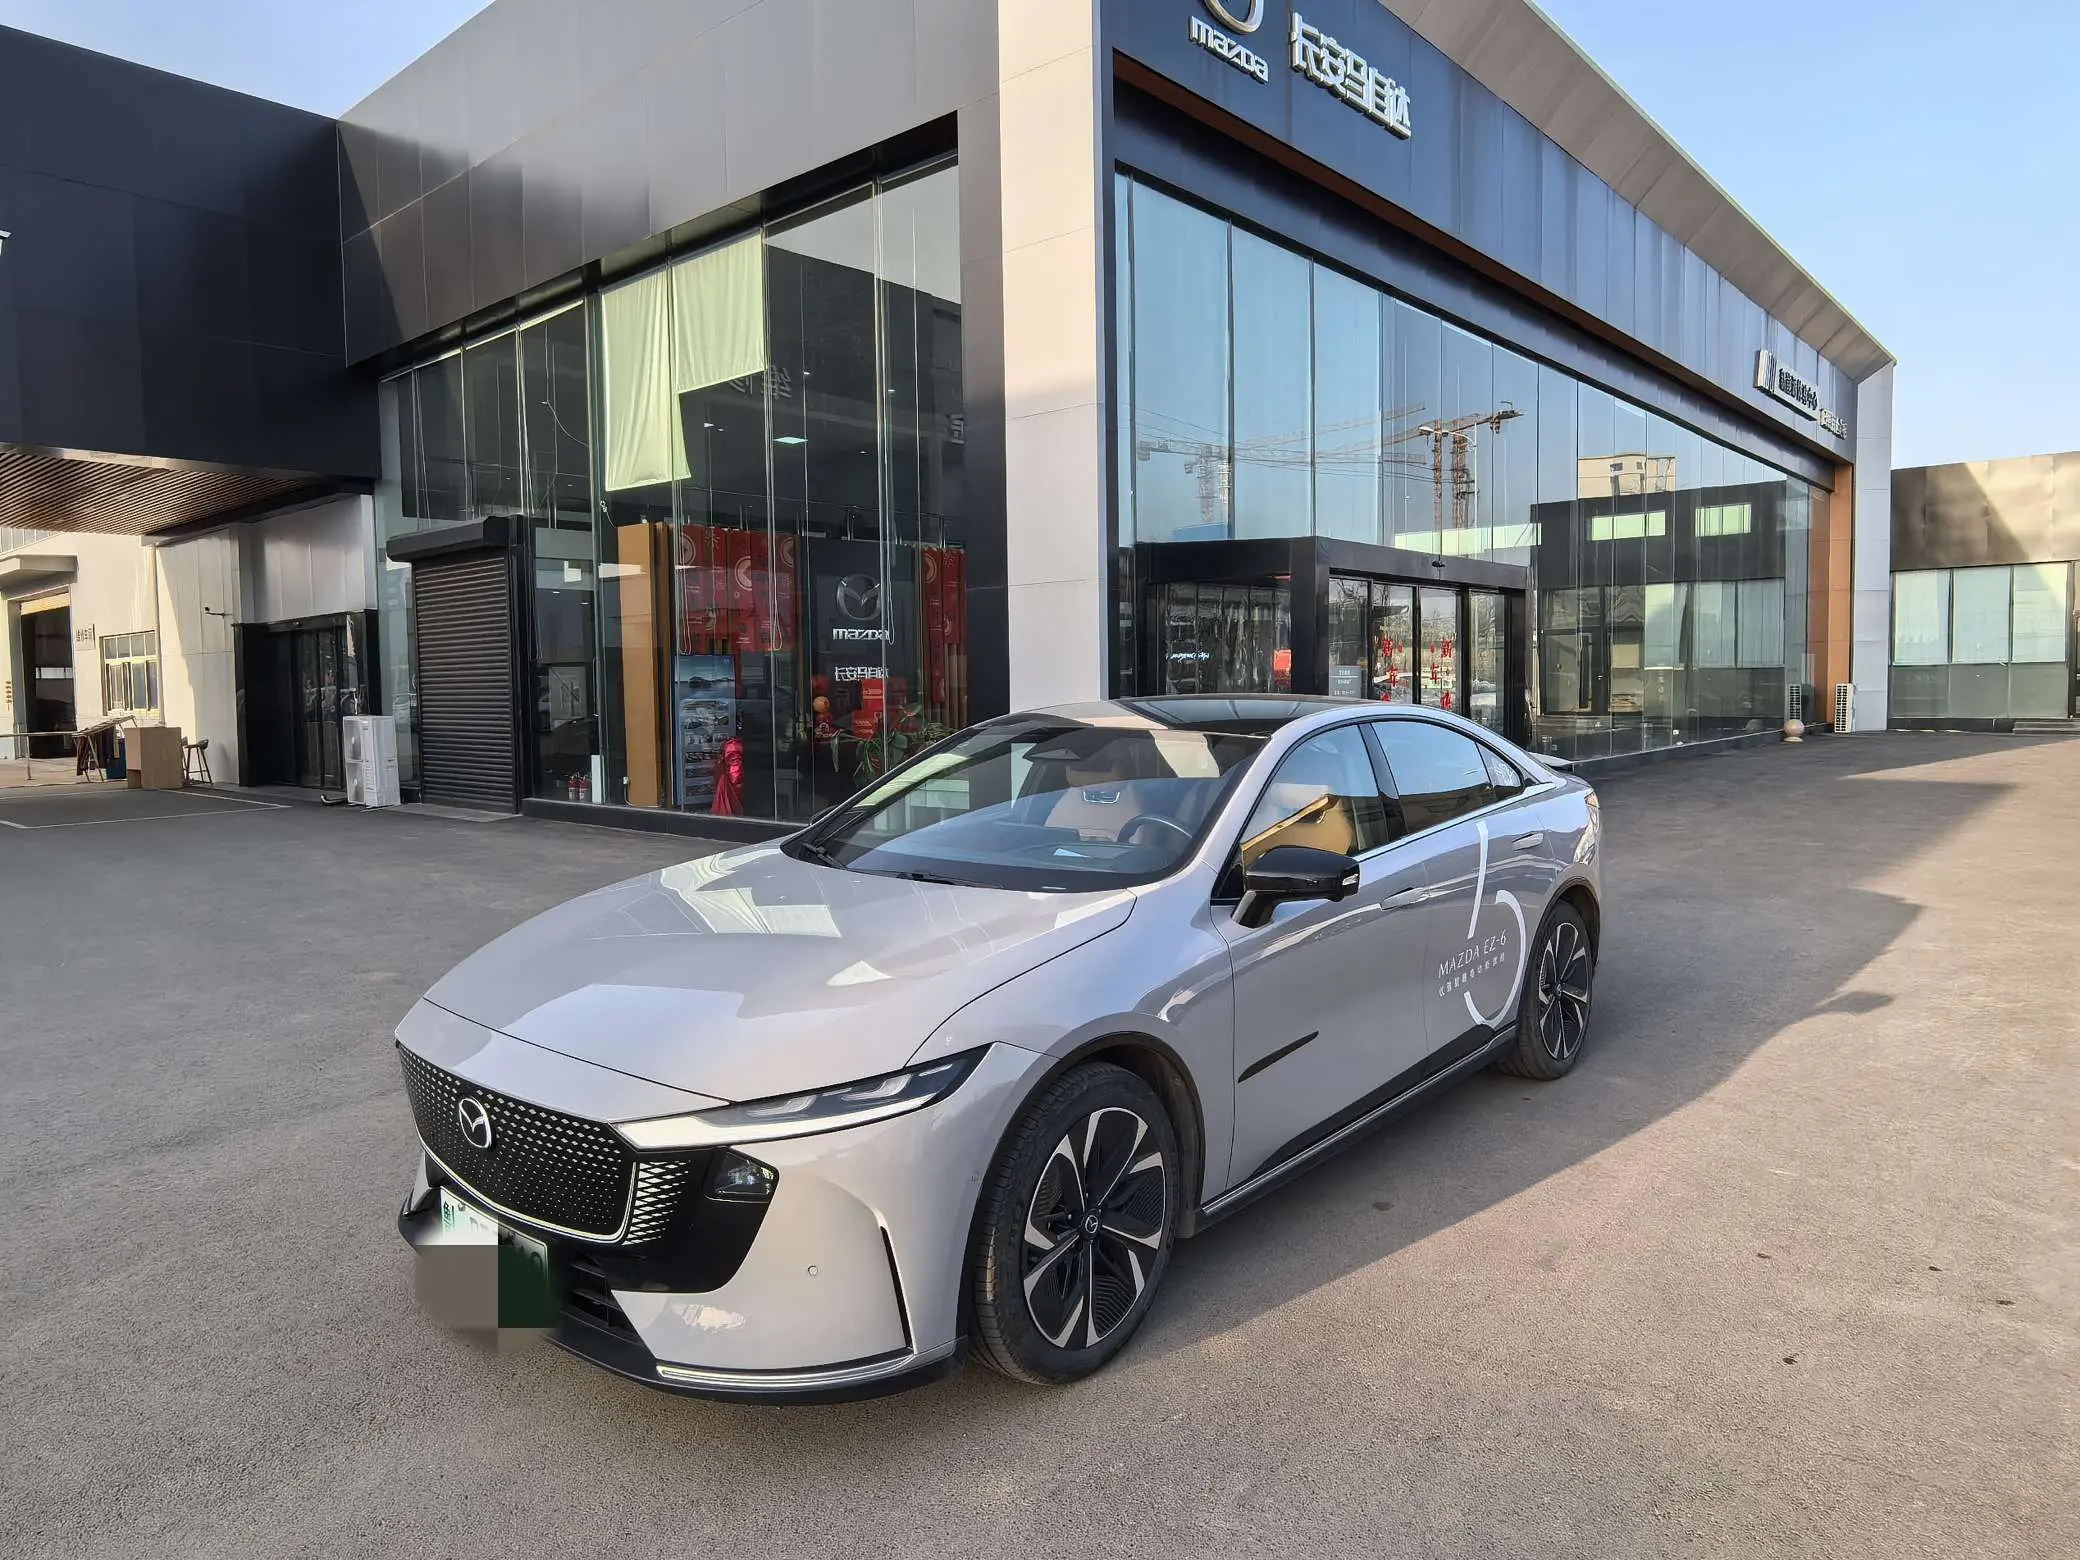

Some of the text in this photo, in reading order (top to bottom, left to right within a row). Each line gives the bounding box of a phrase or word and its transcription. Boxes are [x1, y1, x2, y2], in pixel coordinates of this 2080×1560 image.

[1189, 15, 1269, 84] mazda
[1290, 11, 1411, 140] 长安马自达
[832, 628, 890, 641] mazda
[1438, 945, 1480, 979] MAZDA
[1484, 928, 1507, 955] EZ-6
